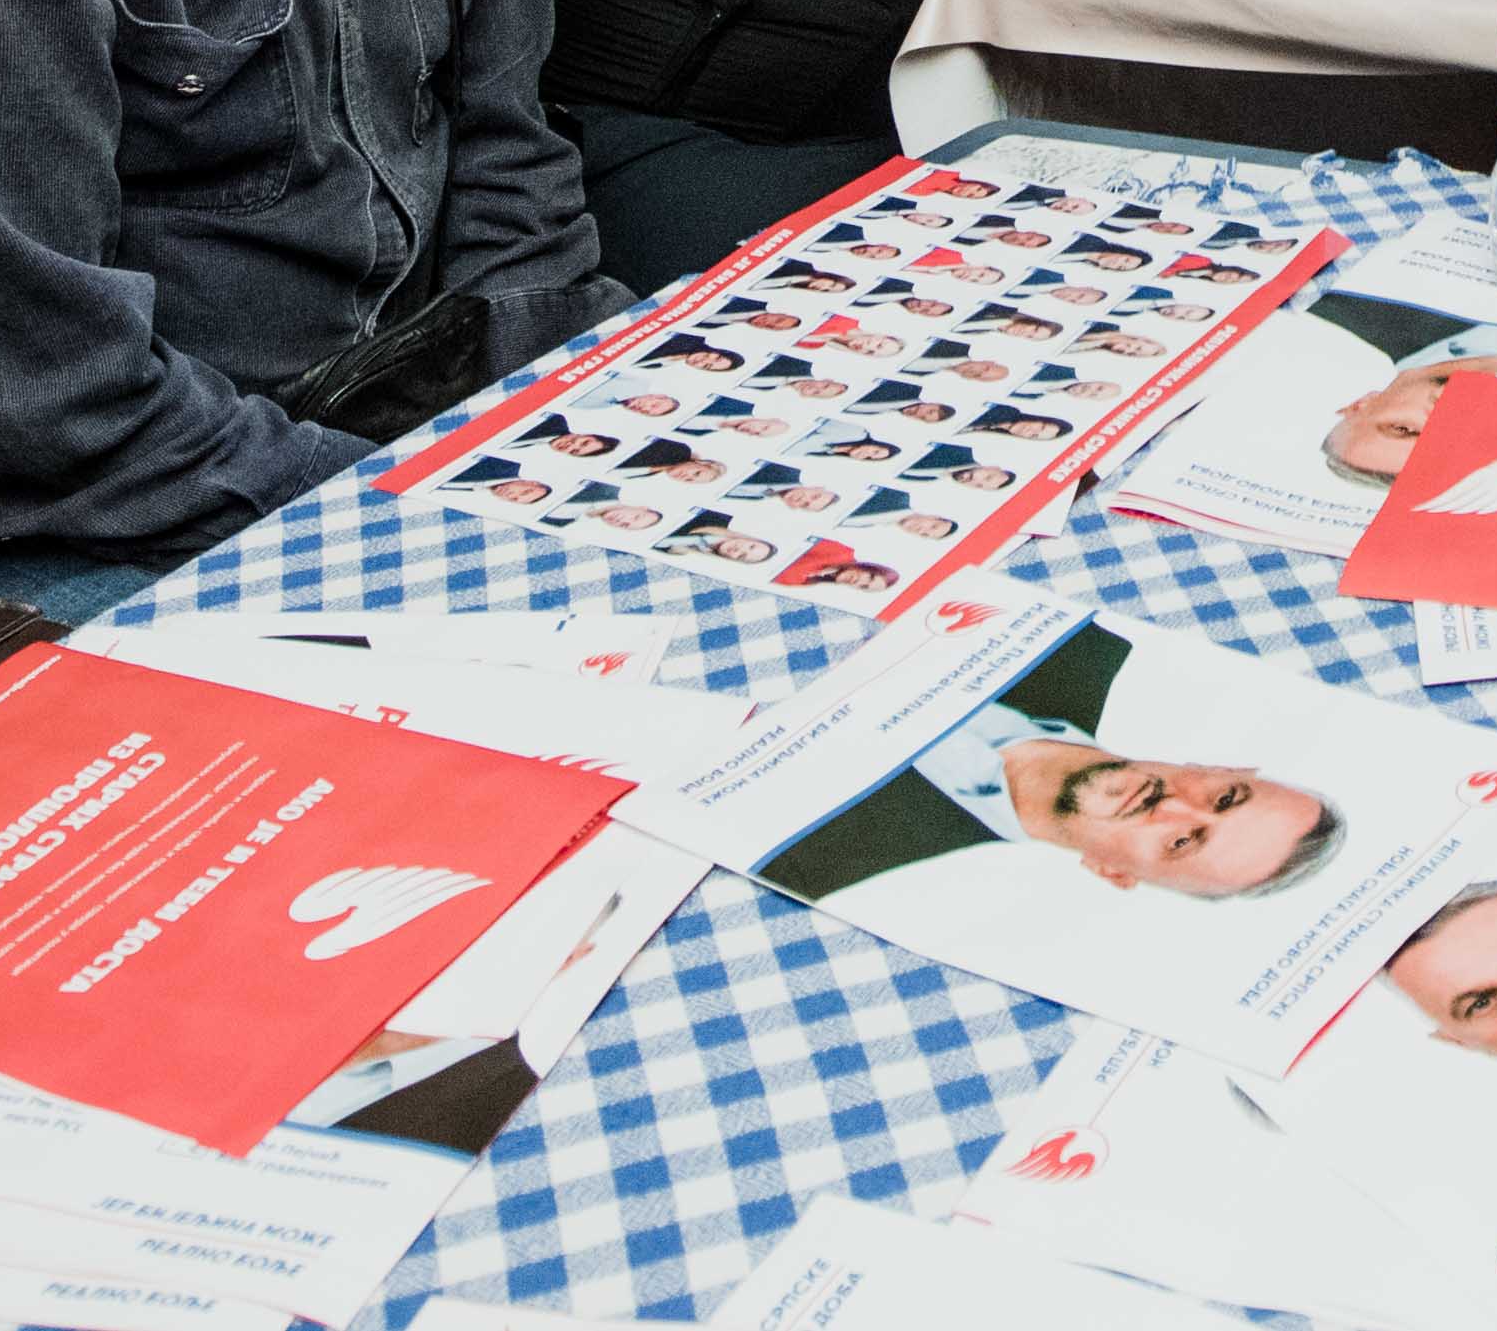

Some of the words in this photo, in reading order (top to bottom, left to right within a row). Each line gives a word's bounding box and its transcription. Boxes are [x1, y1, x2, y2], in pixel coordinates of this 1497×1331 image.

[108, 733, 151, 759] ИЗ
[60, 753, 164, 829] СТАРИХ
[277, 778, 333, 820] АКО
[224, 845, 255, 863] И
[246, 820, 283, 844] ЈЕ
[156, 868, 233, 921] ТЕБИ
[60, 919, 160, 992] ДОСТА
[1095, 1028, 1143, 1083] РЕПУБЛ
